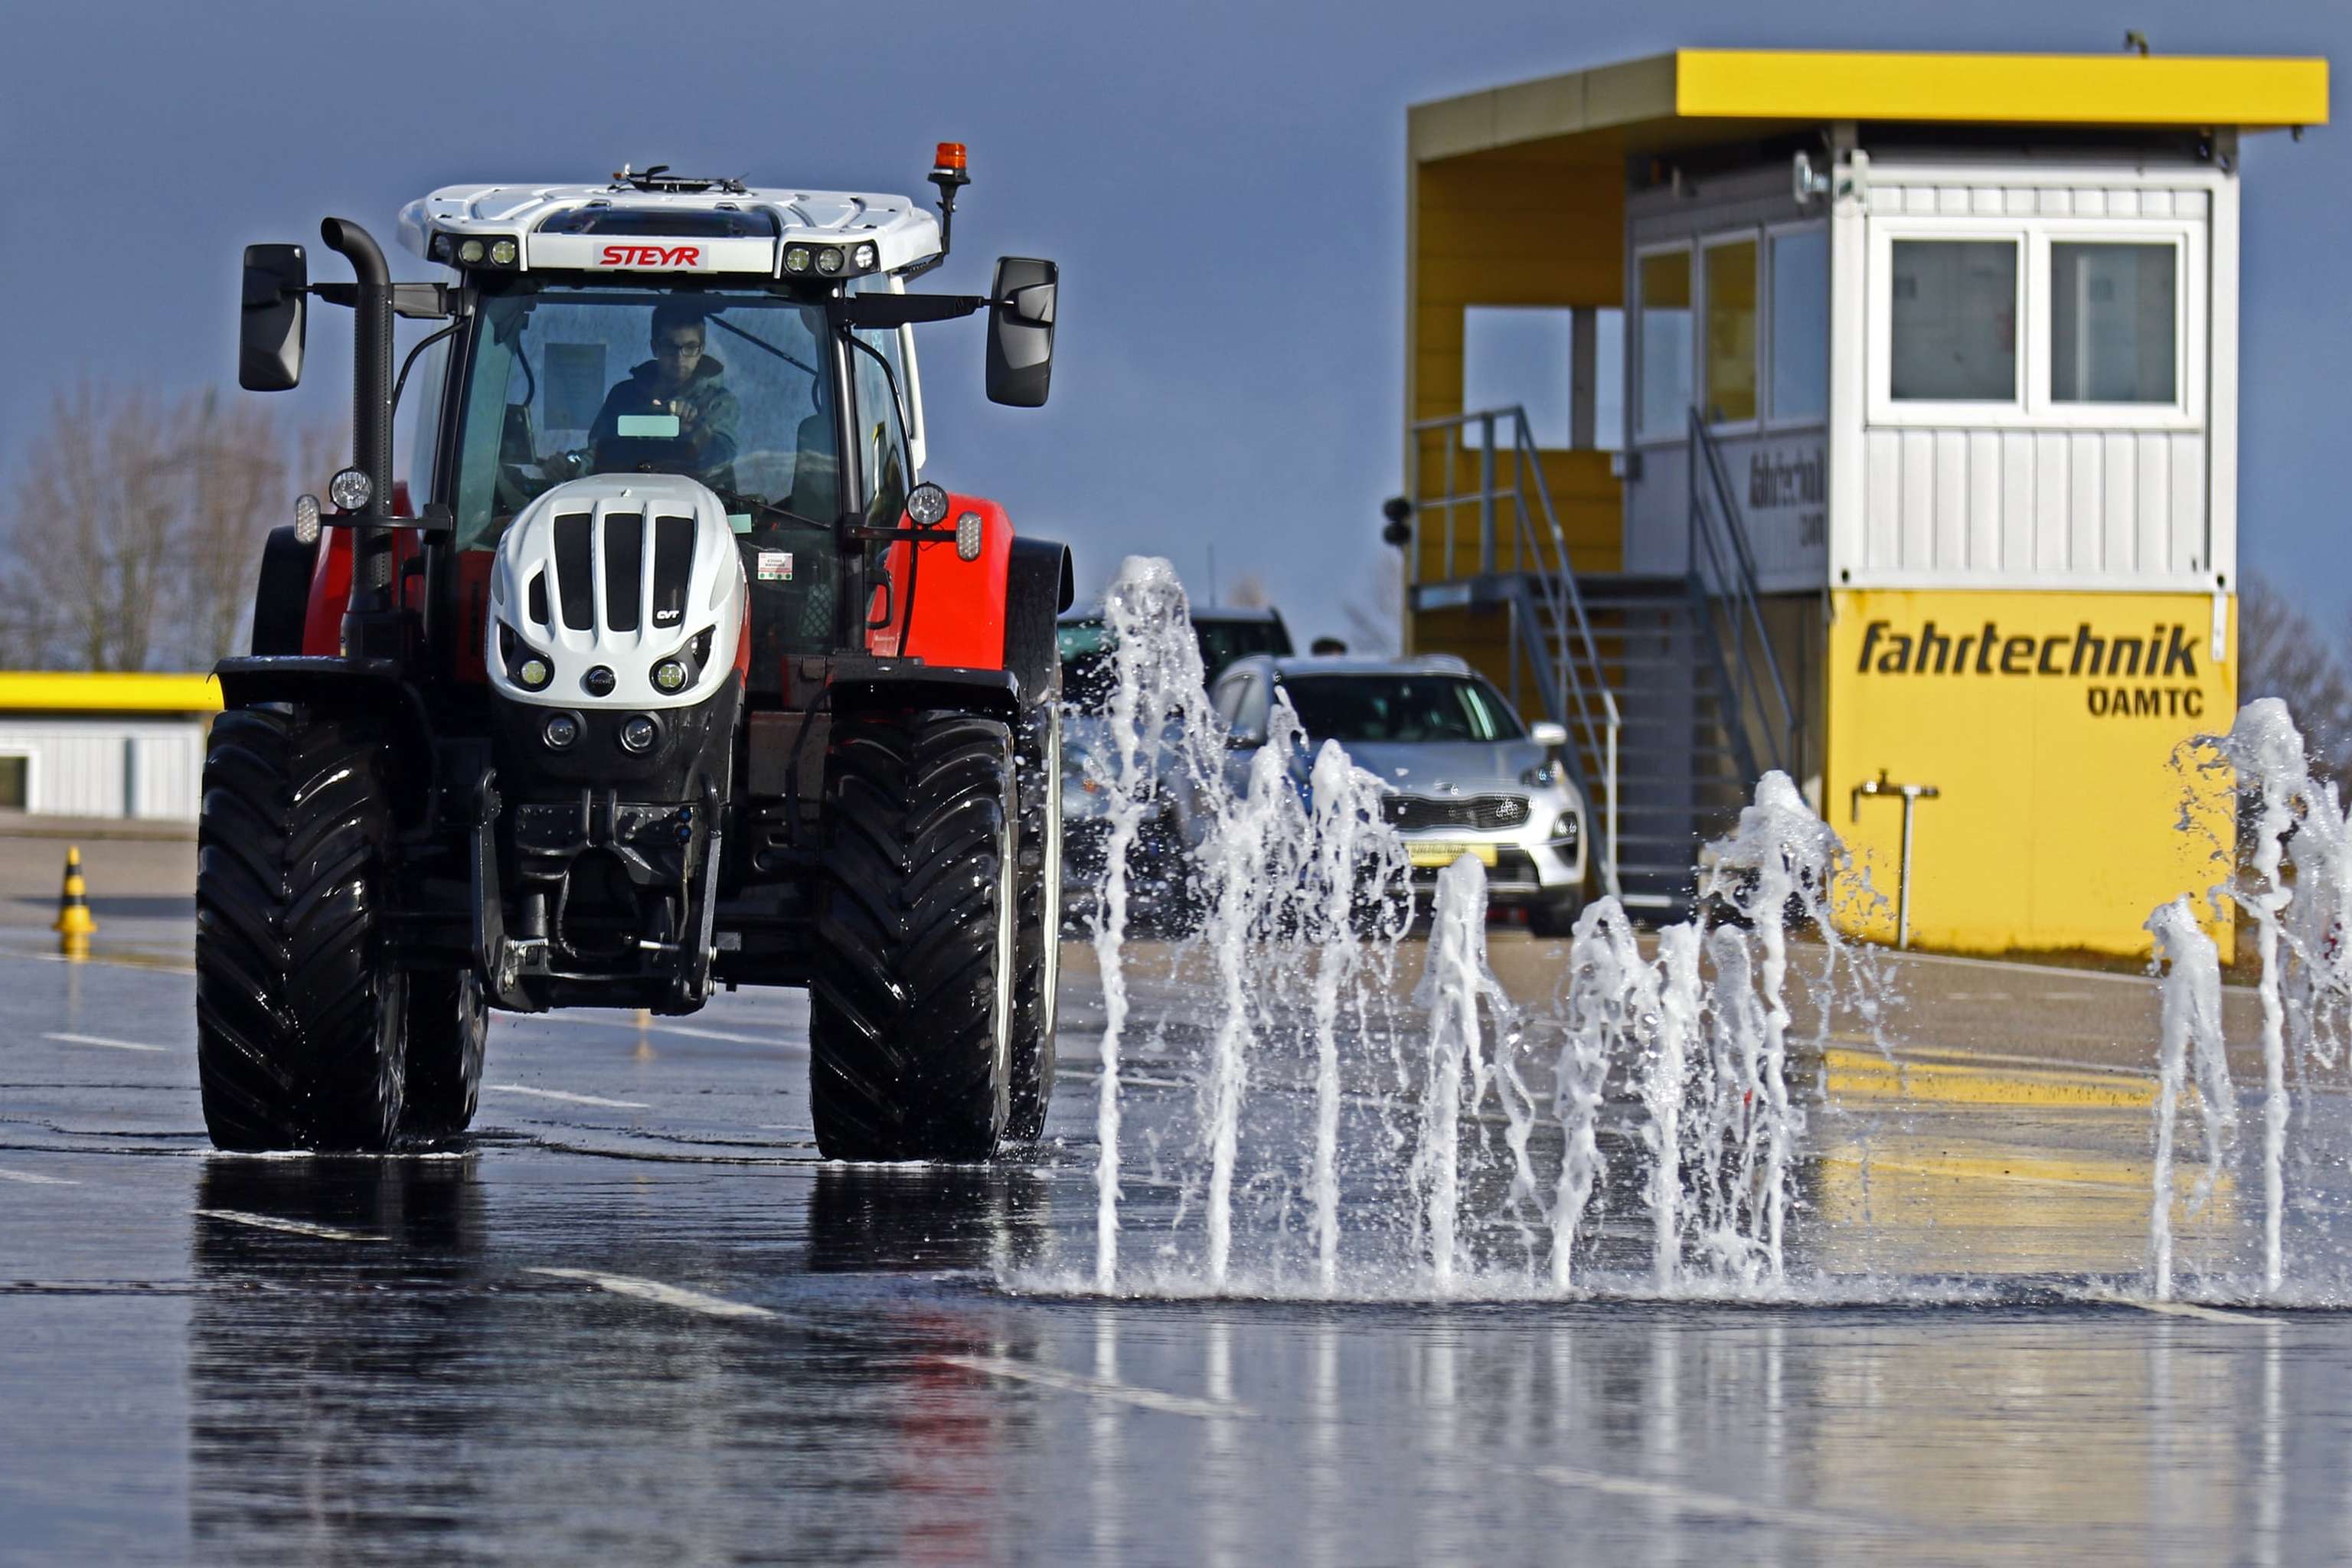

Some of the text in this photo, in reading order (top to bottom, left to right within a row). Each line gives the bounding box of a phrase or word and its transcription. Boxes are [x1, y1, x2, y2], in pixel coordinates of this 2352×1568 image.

[599, 246, 700, 266] STEYR
[657, 609, 680, 619] CVT
[1857, 620, 2200, 678] fahrtechnik
